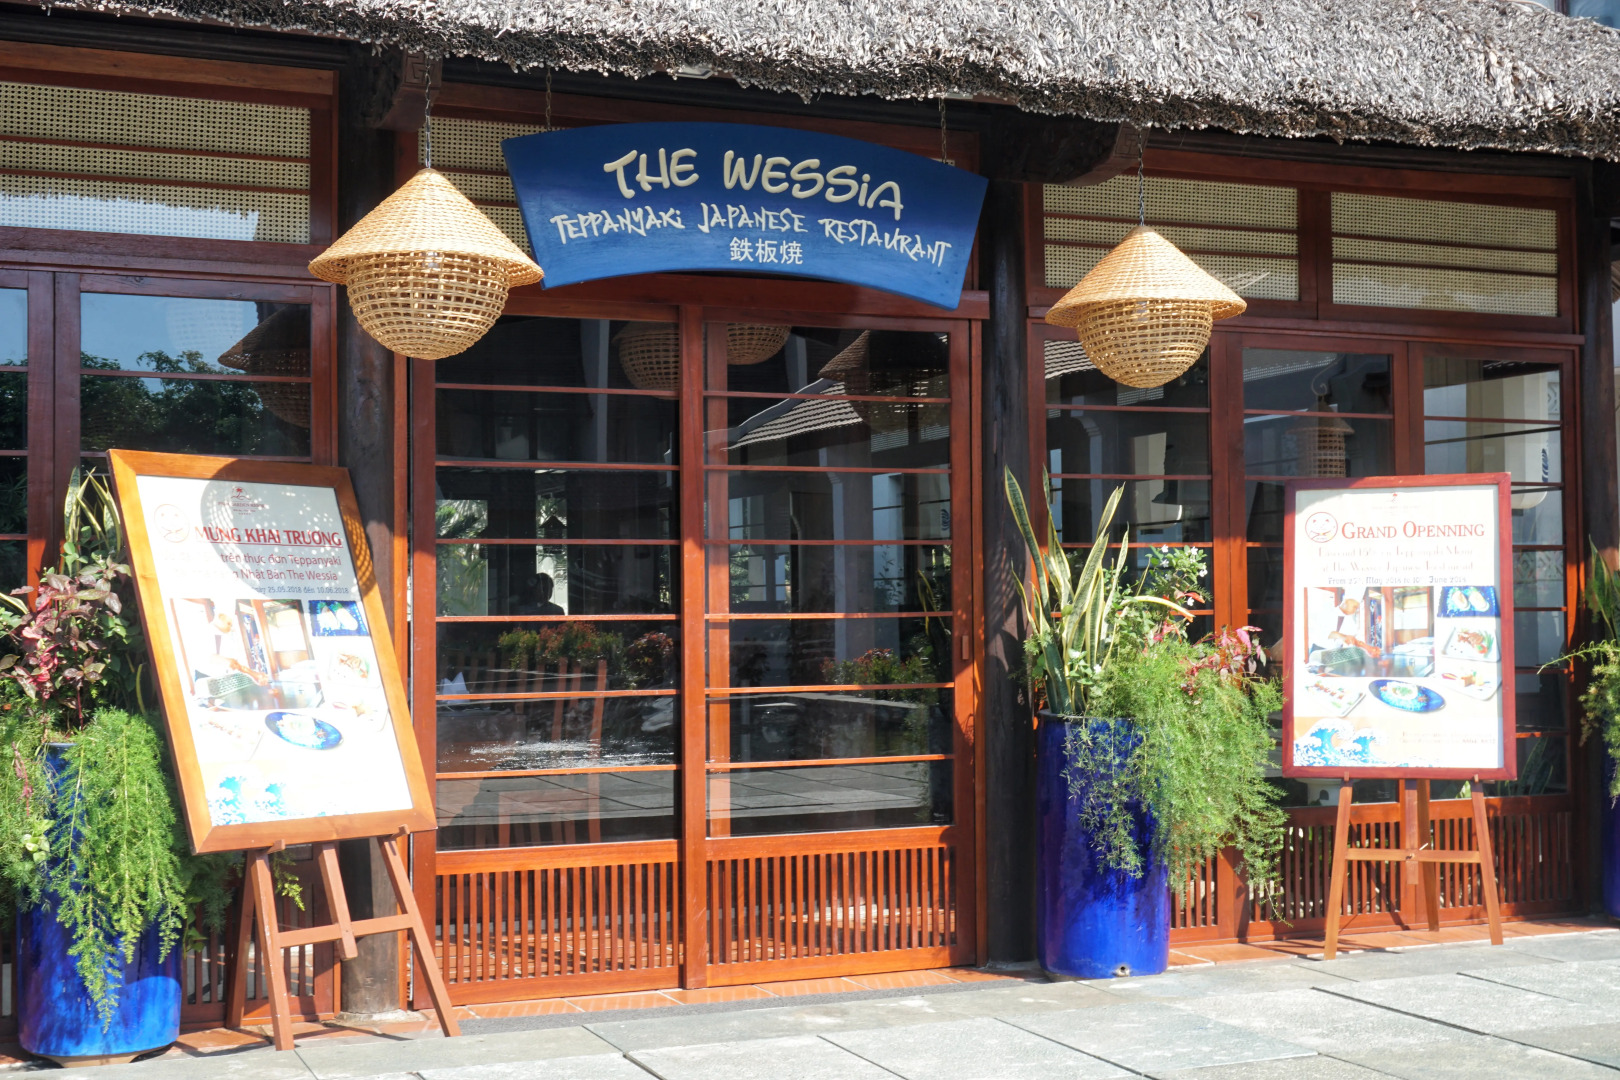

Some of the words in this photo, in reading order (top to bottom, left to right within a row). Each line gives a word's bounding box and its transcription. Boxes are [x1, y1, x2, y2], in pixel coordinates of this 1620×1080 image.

[603, 148, 699, 199] THE
[723, 150, 904, 221] WESSiA
[697, 202, 808, 233] JAPANESE
[818, 218, 952, 267] RESTAURANT
[729, 237, 804, 265] 鉄板焼
[244, 527, 281, 543] KHAI
[283, 529, 342, 546] TRƯƠNG
[1341, 521, 1398, 539] GRAND
[1402, 520, 1485, 538] OPENNING
[287, 554, 342, 568] Teppanyaki
[286, 569, 304, 580] The
[304, 570, 338, 581] Wessia
[1428, 575, 1448, 584] June
